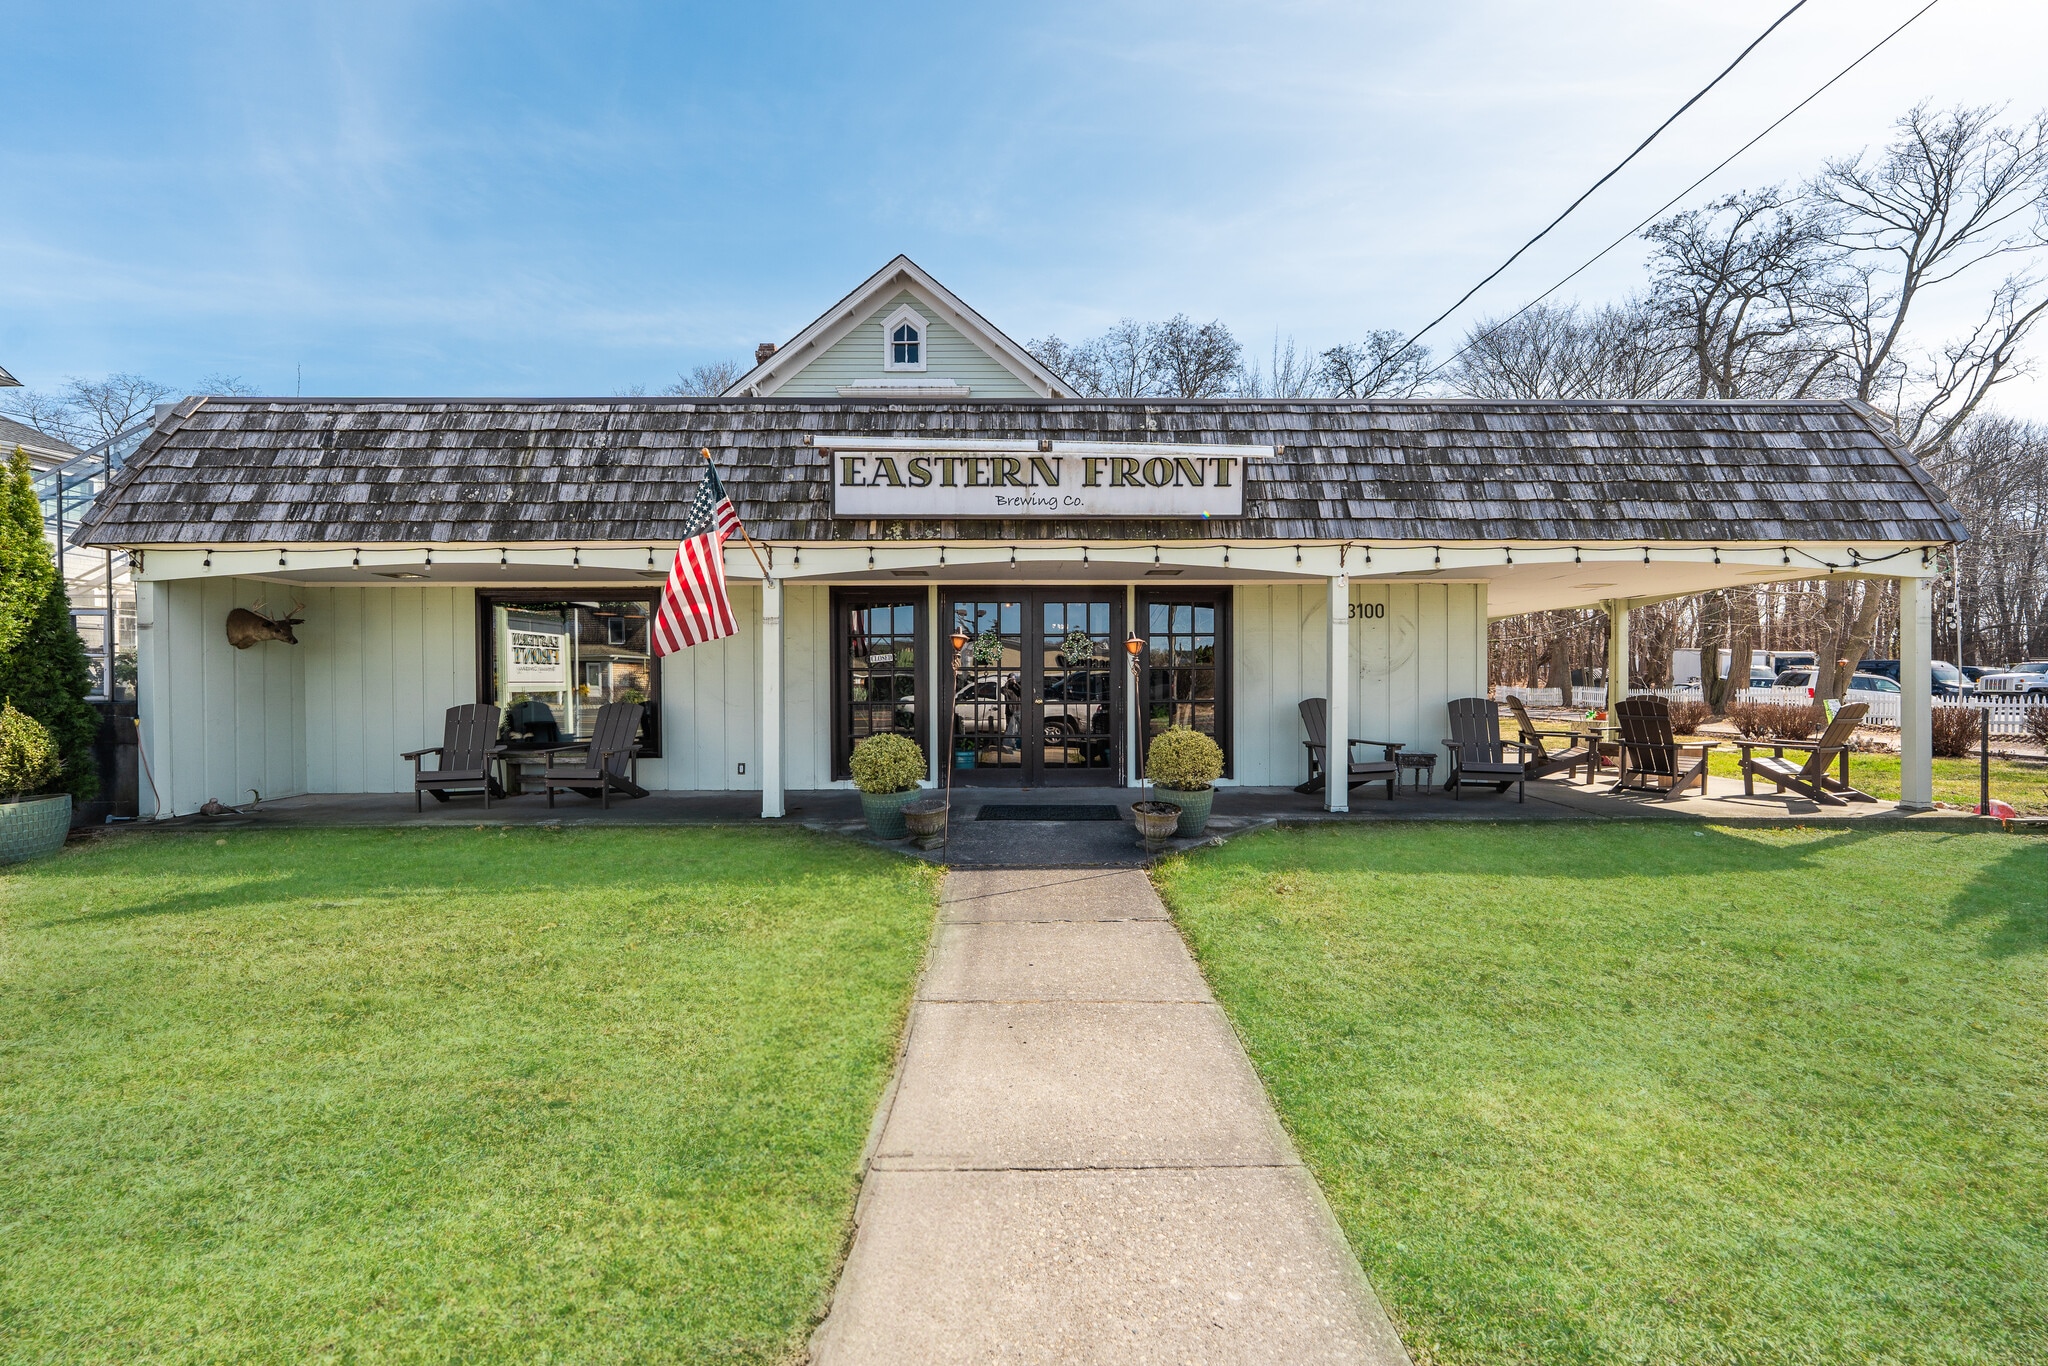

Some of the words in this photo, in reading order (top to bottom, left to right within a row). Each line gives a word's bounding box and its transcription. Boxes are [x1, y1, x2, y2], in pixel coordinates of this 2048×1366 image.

[841, 456, 1063, 488] EASTERN
[1082, 457, 1237, 488] FRONT
[995, 493, 1058, 510] Brewing
[1063, 495, 1085, 506] Co.
